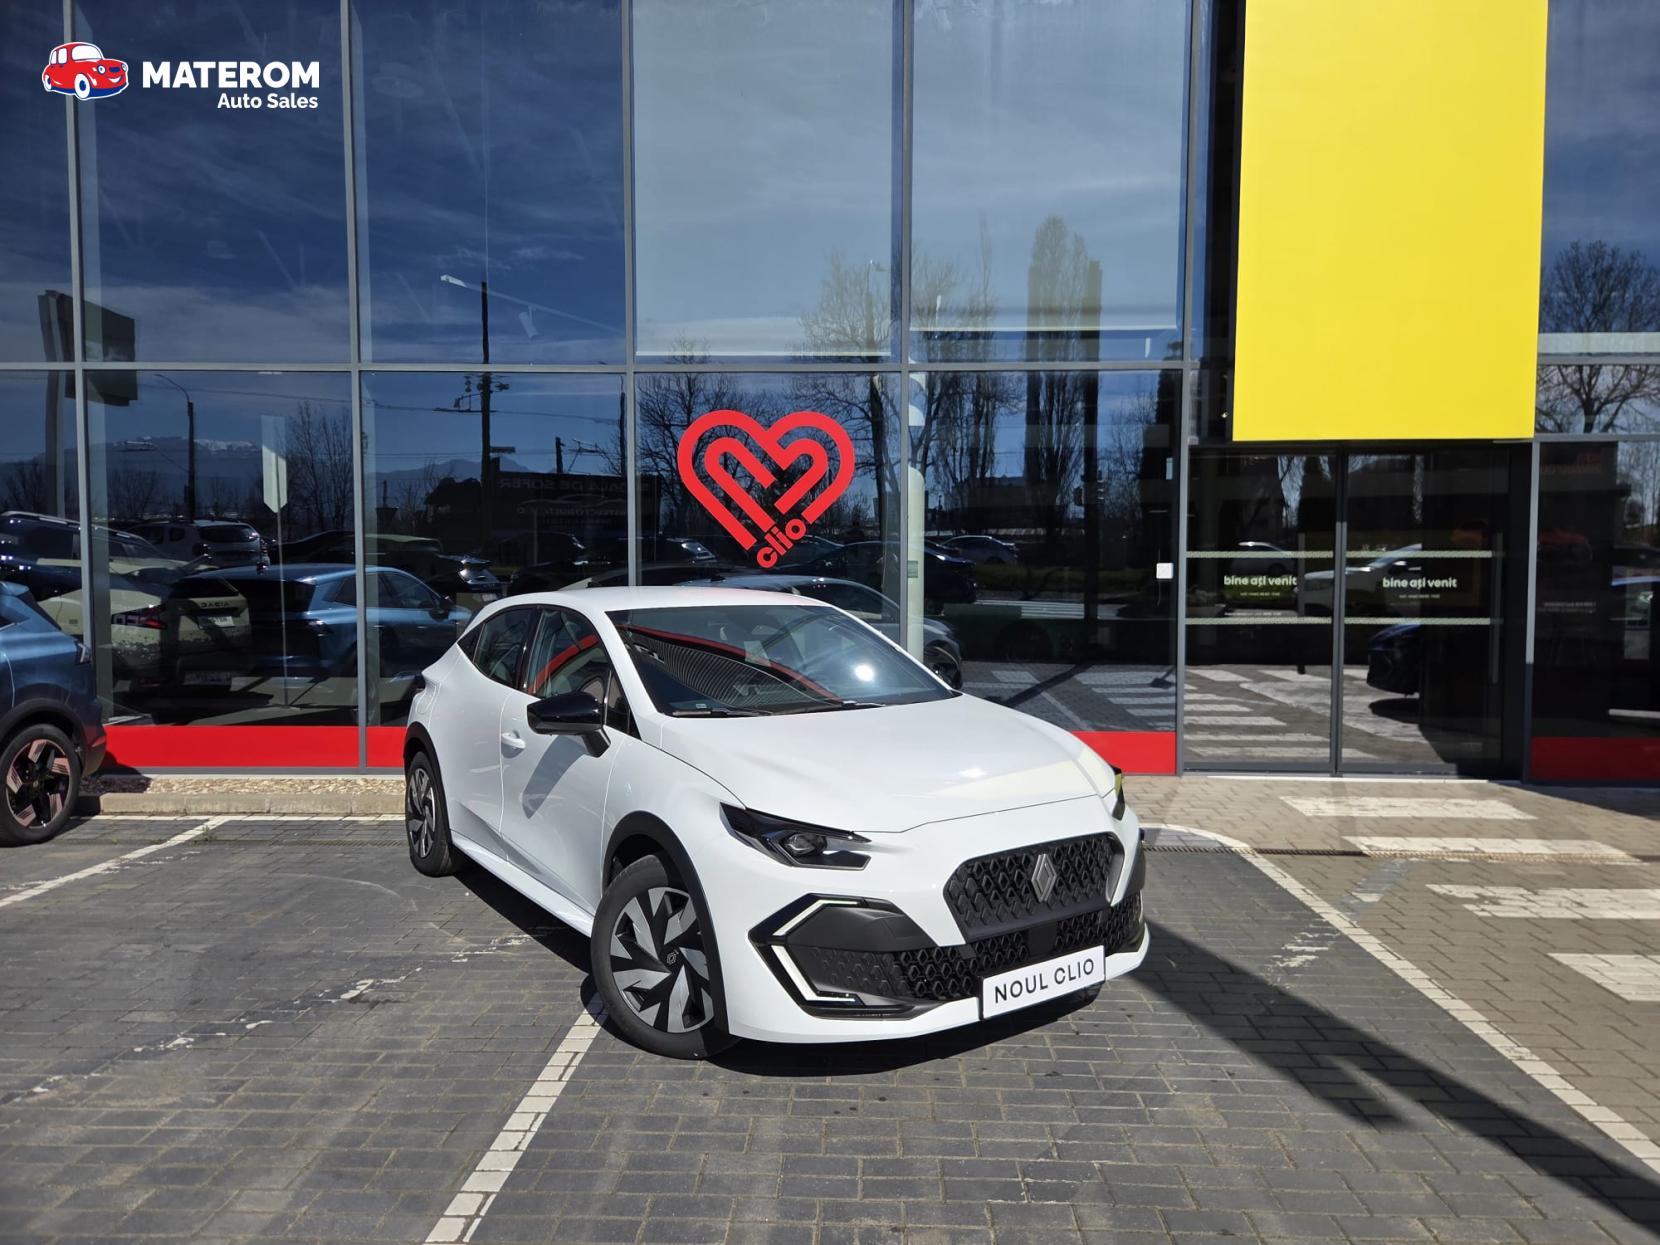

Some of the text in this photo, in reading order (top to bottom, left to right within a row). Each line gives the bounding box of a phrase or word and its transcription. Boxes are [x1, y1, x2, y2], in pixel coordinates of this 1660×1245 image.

[756, 518, 807, 568] clio
[1223, 575, 1249, 586] bine
[1268, 575, 1297, 586] venit
[1382, 577, 1408, 588] bine
[1427, 577, 1457, 588] venit
[995, 958, 1094, 1004] NOUL CLIO
